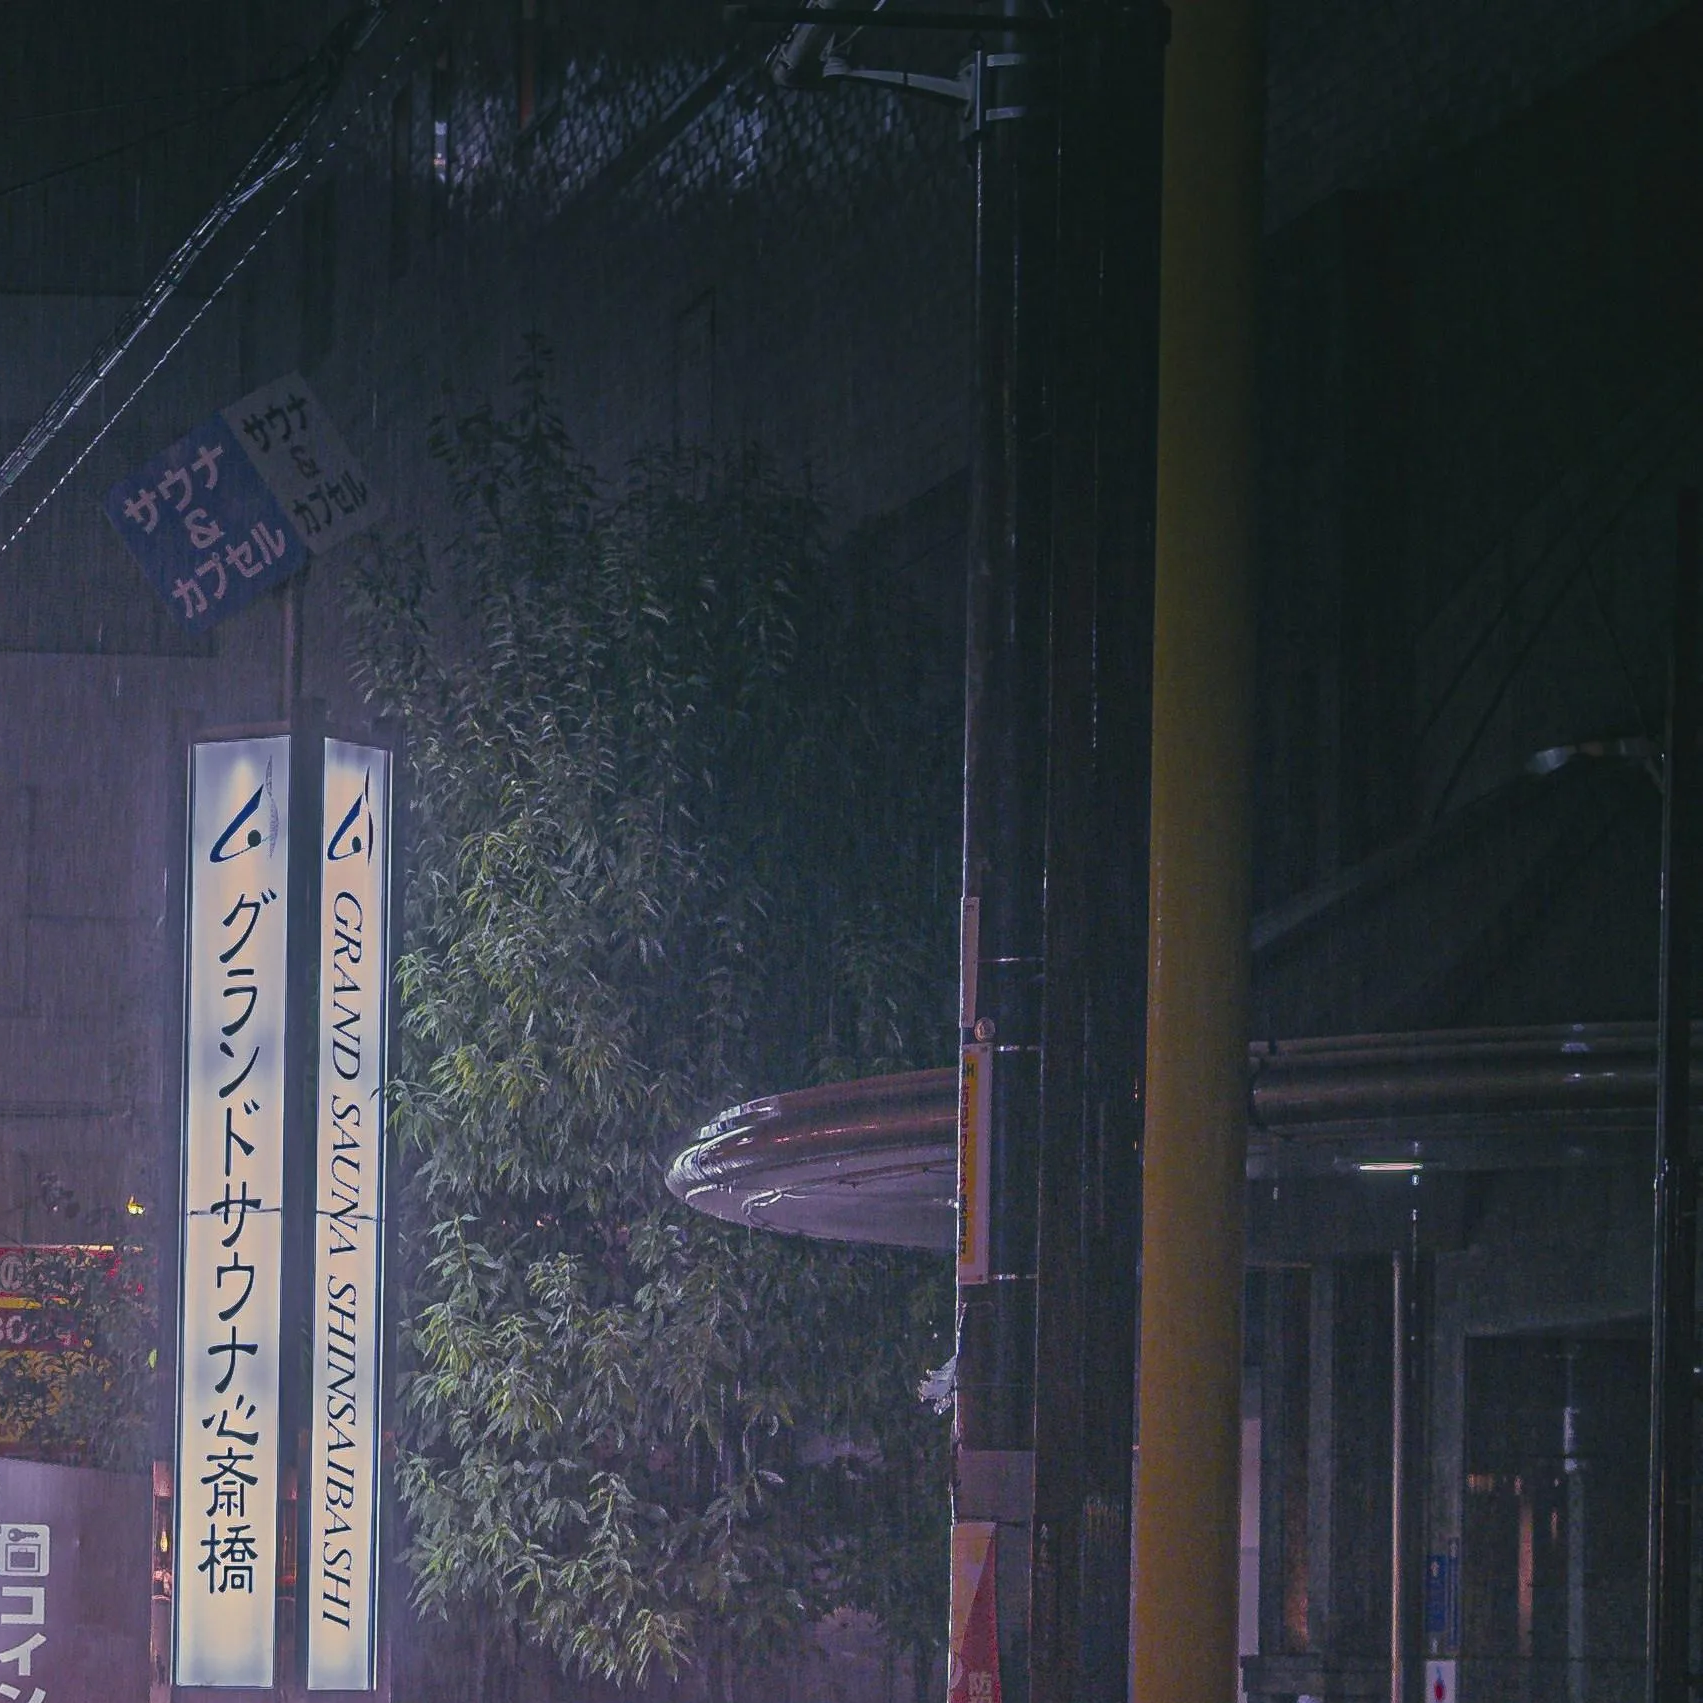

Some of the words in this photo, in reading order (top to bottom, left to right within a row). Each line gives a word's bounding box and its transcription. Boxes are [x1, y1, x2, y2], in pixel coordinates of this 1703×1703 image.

[123, 443, 226, 534] サウナ
[242, 393, 310, 454] サウナ
[171, 519, 286, 619] カプセル
[186, 508, 227, 550] &
[332, 891, 363, 1082] GRAND
[198, 887, 278, 1597] グランドサウナ心斎橋
[327, 1095, 363, 1259] SAUNA
[320, 1274, 358, 1632] SHINSAIBASHI
